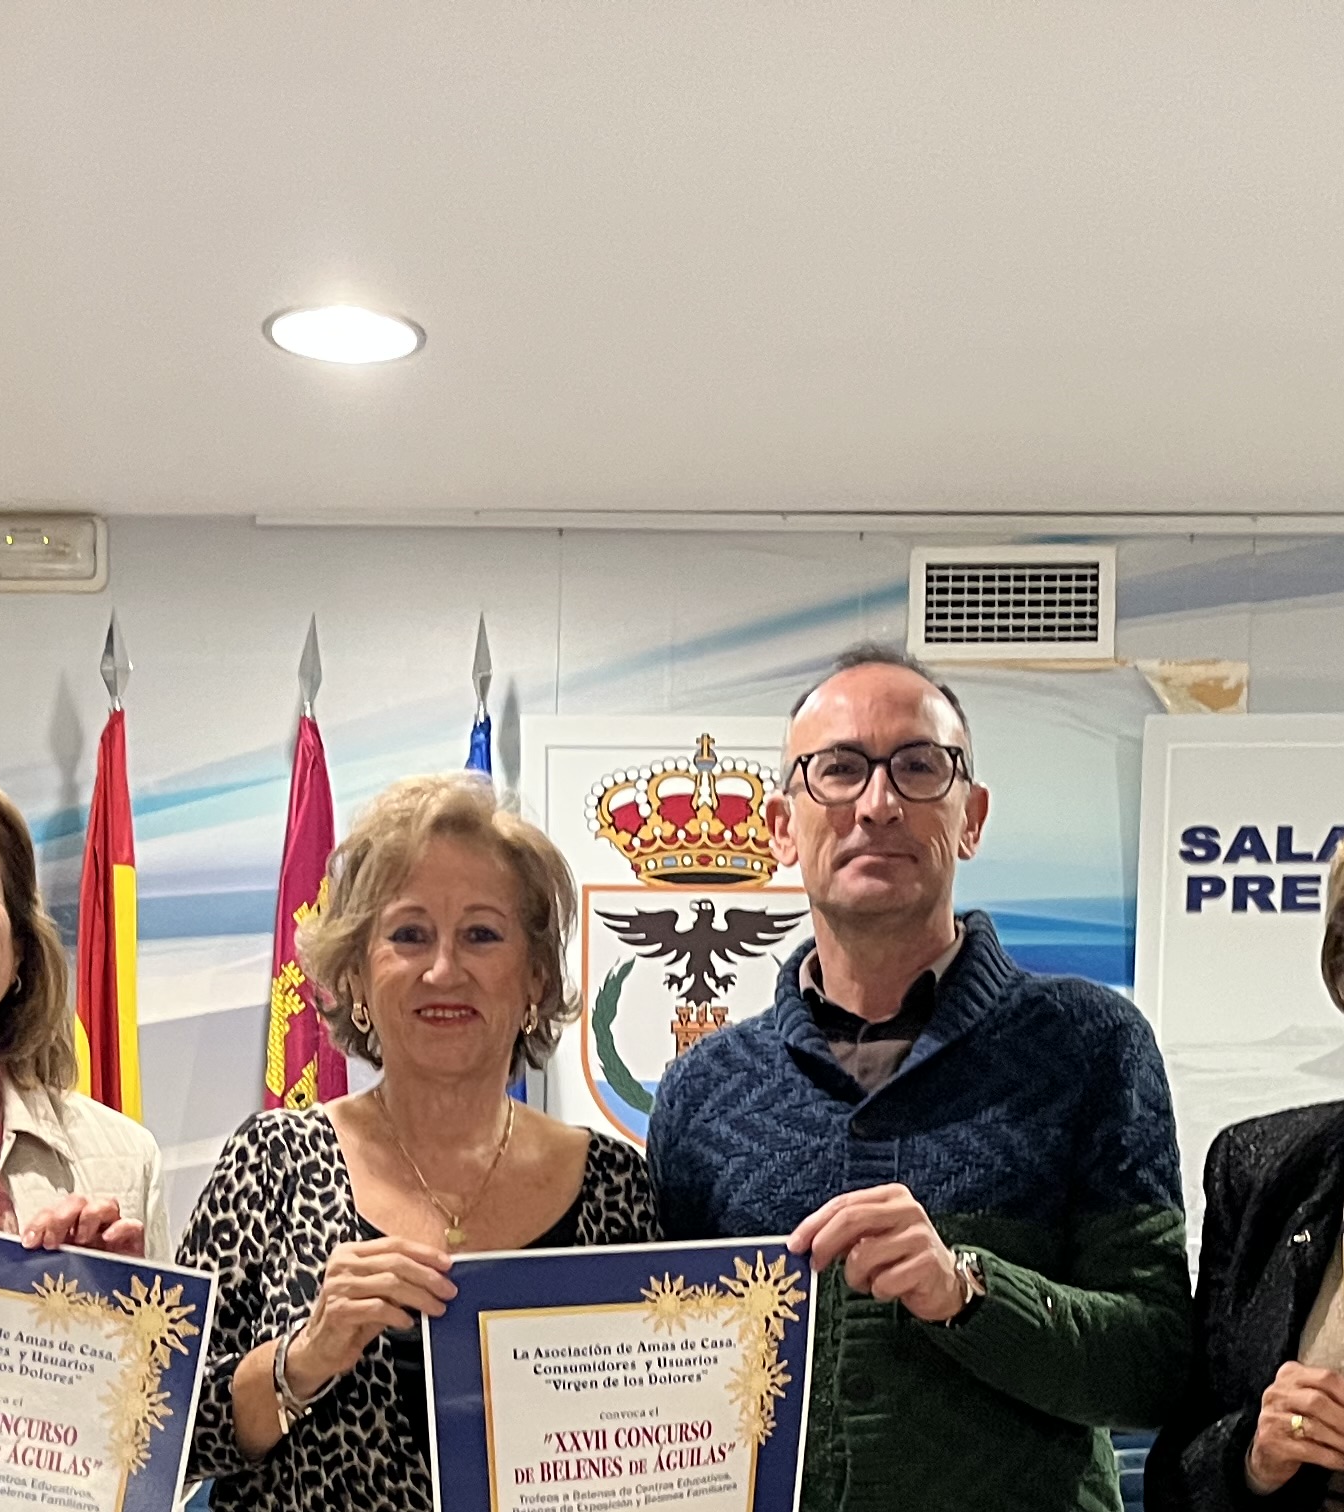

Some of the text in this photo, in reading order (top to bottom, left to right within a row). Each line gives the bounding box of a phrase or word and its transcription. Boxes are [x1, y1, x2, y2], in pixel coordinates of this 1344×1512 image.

[1186, 874, 1321, 914] PRE
[14, 1330, 54, 1349] Amas
[58, 1340, 75, 1353] de
[79, 1343, 116, 1362] Casa,
[513, 1337, 736, 1360] La Asociación de Amas de Casa,
[19, 1350, 26, 1363] y
[31, 1351, 95, 1374] Usuarios
[533, 1354, 718, 1376] Consumidores y Usuarios
[18, 1364, 82, 1386] Dolores"
[545, 1369, 708, 1392] "Virgen de los Dolores"
[599, 1406, 659, 1421] convoca el
[544, 1420, 712, 1454] "XXVII CONCURSO
[6, 1438, 104, 1478] ÁGUILAS"
[514, 1442, 736, 1485] DE BELENES DE ÁGUILAS"
